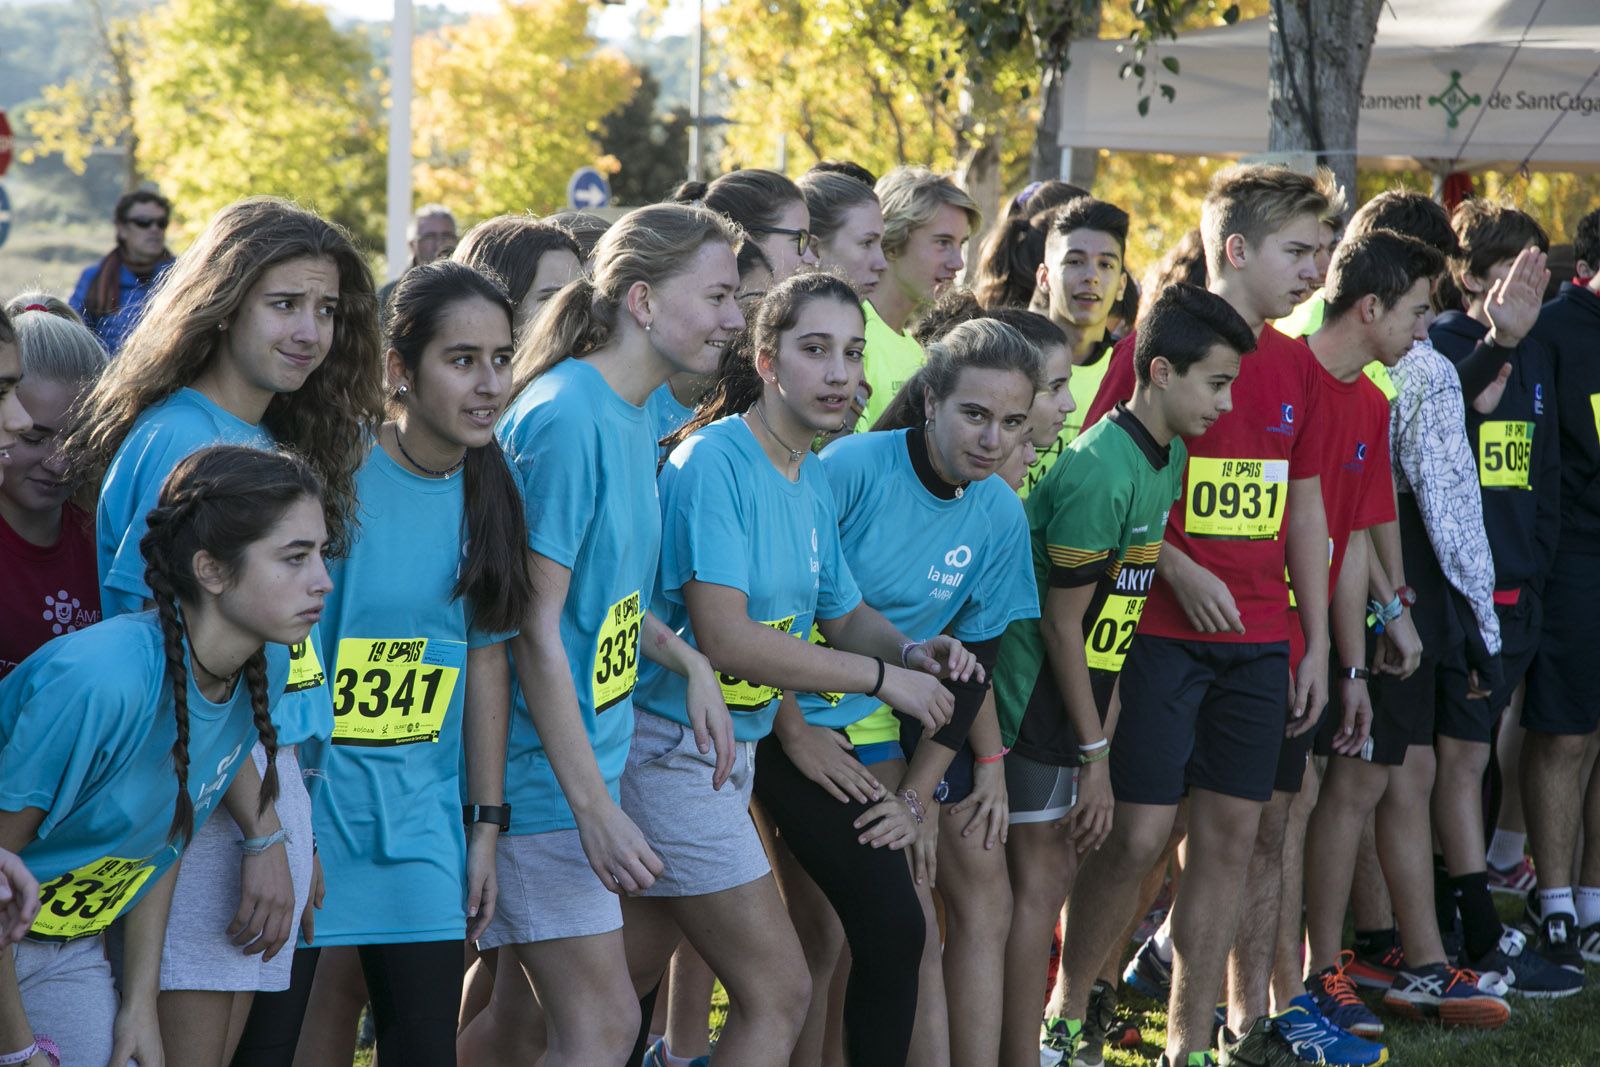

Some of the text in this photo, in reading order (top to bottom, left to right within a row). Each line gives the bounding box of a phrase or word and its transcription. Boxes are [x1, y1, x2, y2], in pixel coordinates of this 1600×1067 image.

[1488, 92, 1512, 110] de
[1484, 441, 1530, 472] 5095
[1221, 461, 1262, 478] 19 CROS
[1192, 481, 1279, 519] 0931
[927, 565, 964, 588] la vall
[614, 604, 622, 626] 19
[1124, 599, 1136, 615] 19
[1091, 618, 1138, 655] 02
[367, 641, 387, 662] 19
[386, 640, 424, 663] CROS
[333, 668, 444, 718] 3341
[93, 859, 114, 876] 19
